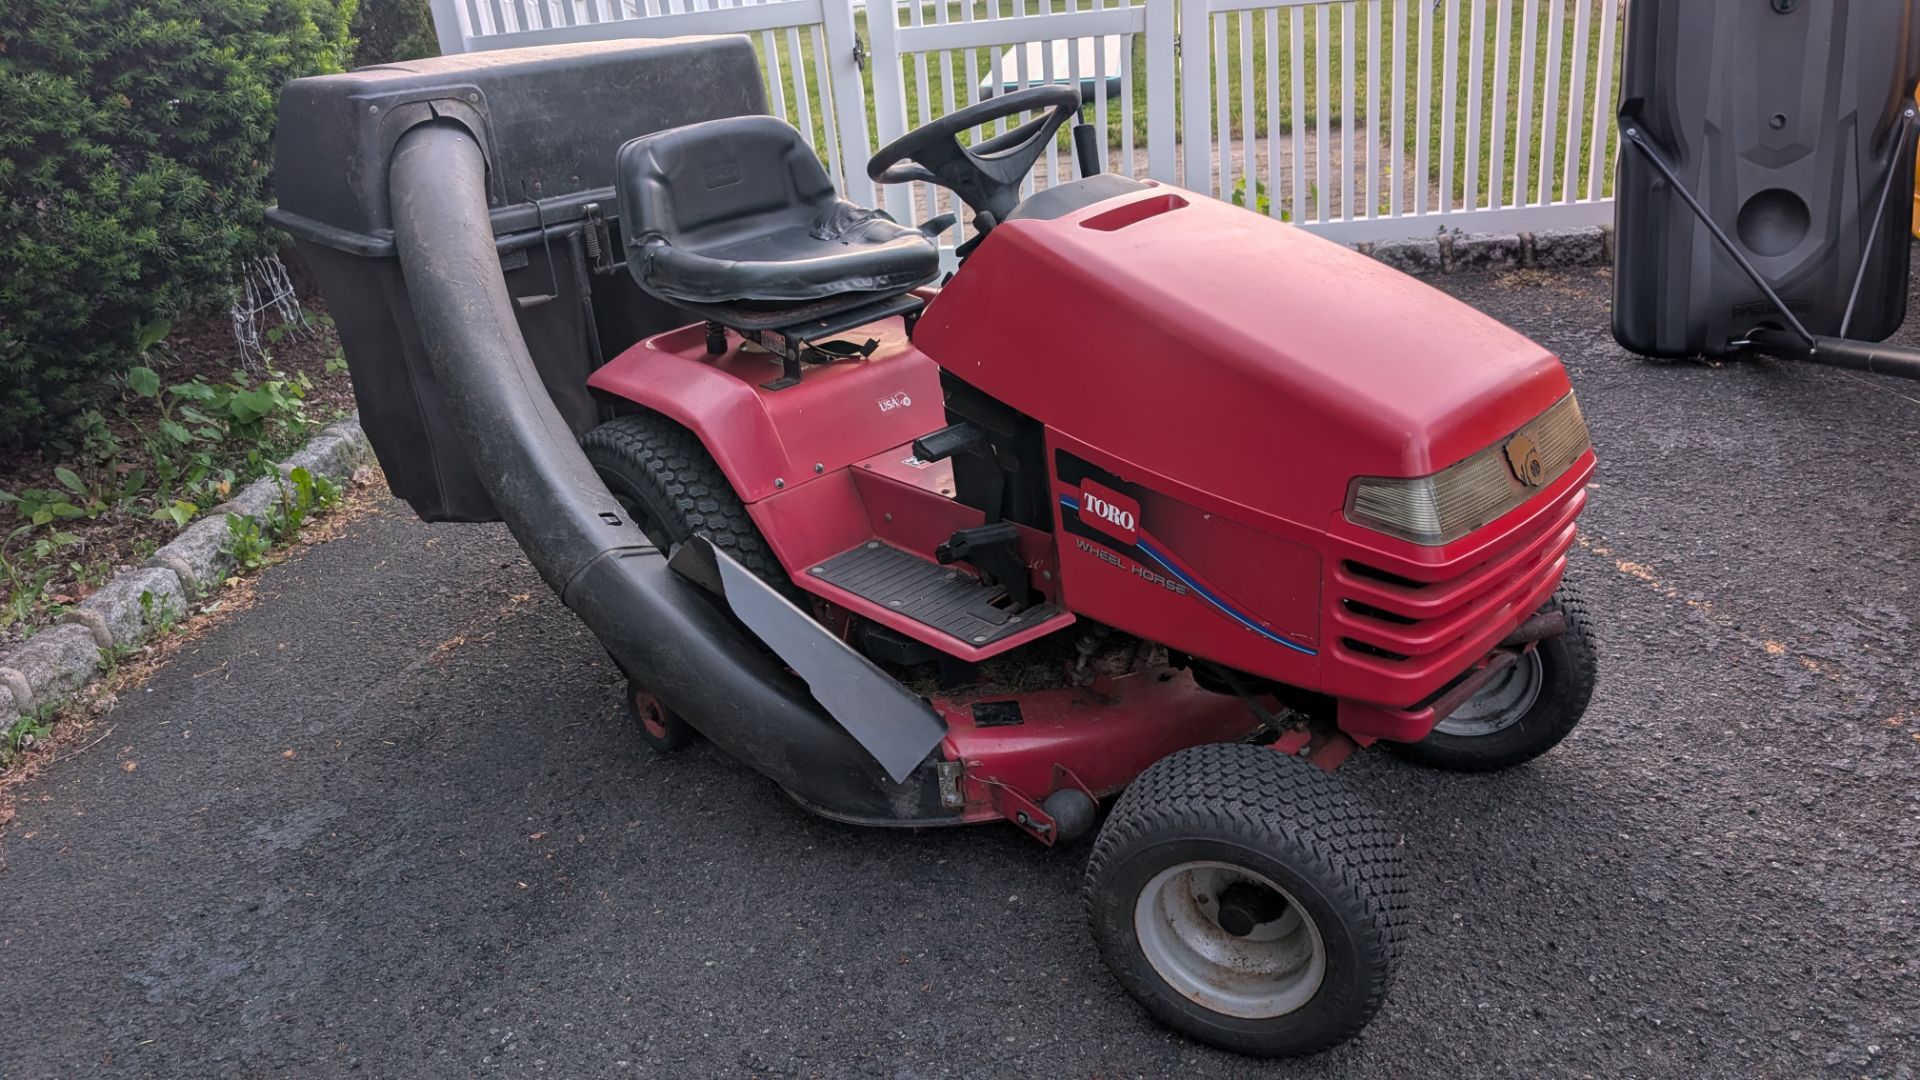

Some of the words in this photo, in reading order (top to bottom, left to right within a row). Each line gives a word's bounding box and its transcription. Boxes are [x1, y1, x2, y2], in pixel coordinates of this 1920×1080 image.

[880, 398, 899, 412] USA
[1084, 493, 1134, 531] TORO
[1076, 539, 1126, 569] WHEEL
[1131, 565, 1186, 595] HORSE
